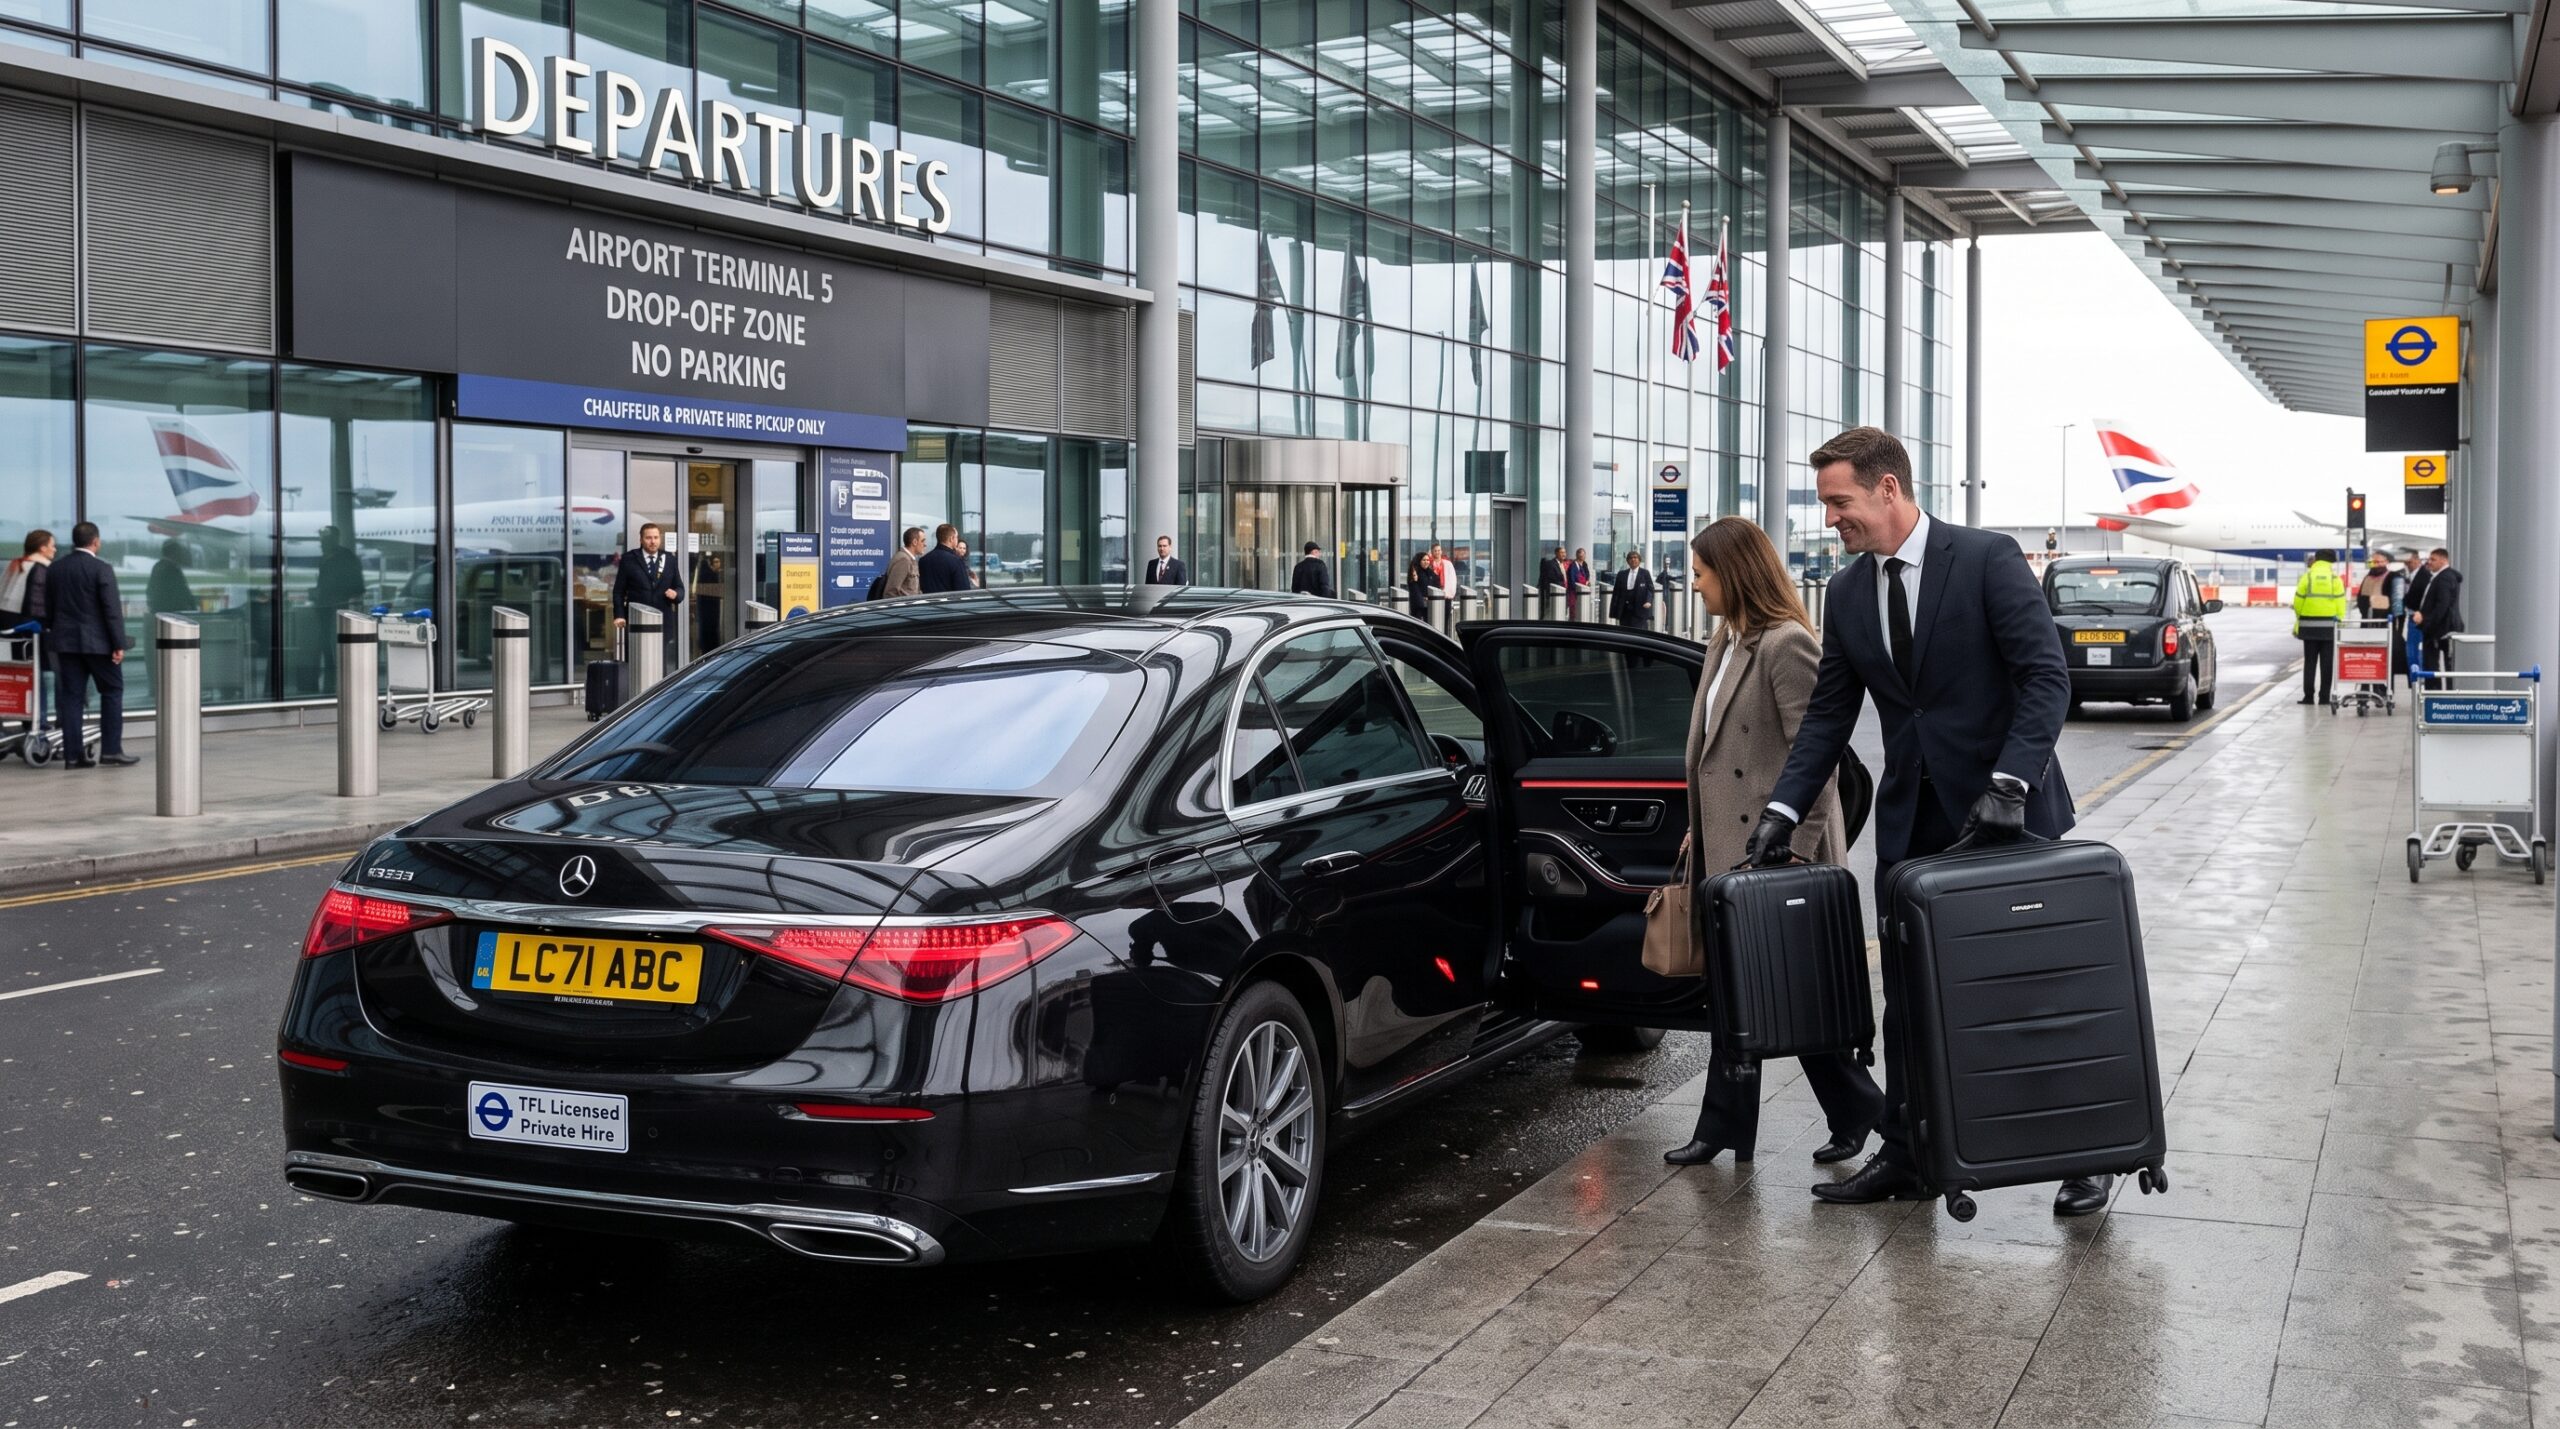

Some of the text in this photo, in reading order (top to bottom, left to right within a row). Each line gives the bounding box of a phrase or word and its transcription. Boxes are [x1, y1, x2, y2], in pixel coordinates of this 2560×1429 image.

[472, 36, 952, 234] DEPARTURES
[566, 227, 834, 303] AIRPORT TERMINAL 5
[607, 285, 806, 346] DROP-OFF ZONE
[632, 341, 786, 390] NO PARKING
[583, 398, 826, 436] CHAUFFEUR & PRIVATE HIRE PICKUP ONLY
[509, 941, 683, 992] LC71 ABC
[519, 1096, 619, 1120] TFL Licensed
[521, 1118, 614, 1142] Private Hire
